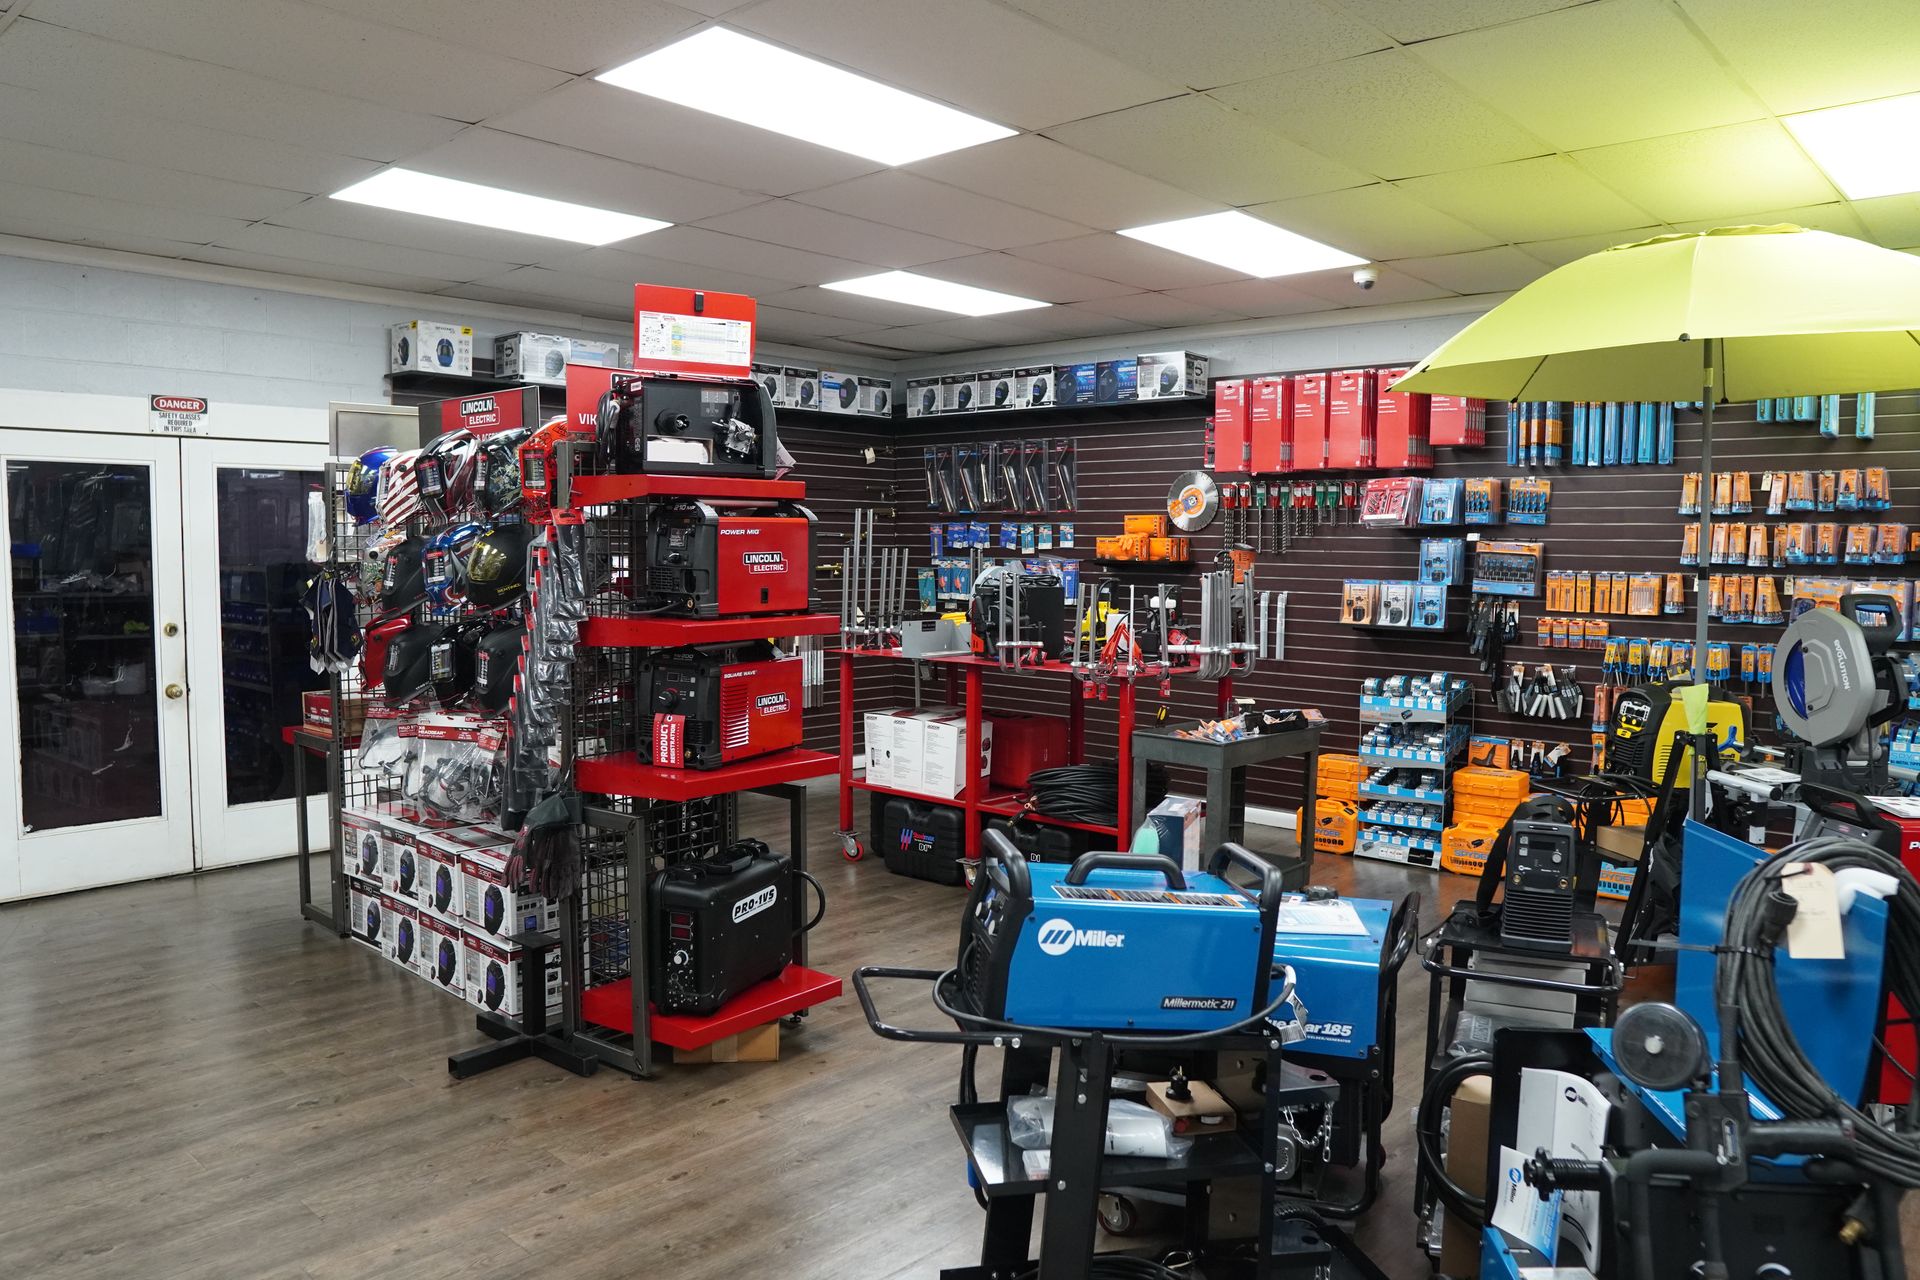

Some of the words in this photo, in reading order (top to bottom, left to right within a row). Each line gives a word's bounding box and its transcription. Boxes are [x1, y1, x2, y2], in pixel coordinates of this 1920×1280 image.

[159, 399, 200, 410] DANGER
[462, 398, 493, 415] LINCOLN
[469, 413, 497, 426] ELECTRIC
[578, 413, 598, 426] VIK
[745, 553, 781, 564] LINCOLN
[753, 564, 784, 572] ELECTRIC
[757, 694, 785, 707] LINCOLN
[763, 703, 787, 714] ELECTRIC
[734, 888, 775, 917] PRO-1VS
[1075, 929, 1125, 948] Miller
[1163, 997, 1219, 1009] Millermatic
[1220, 999, 1235, 1009] 211
[1321, 1023, 1353, 1037] 185
